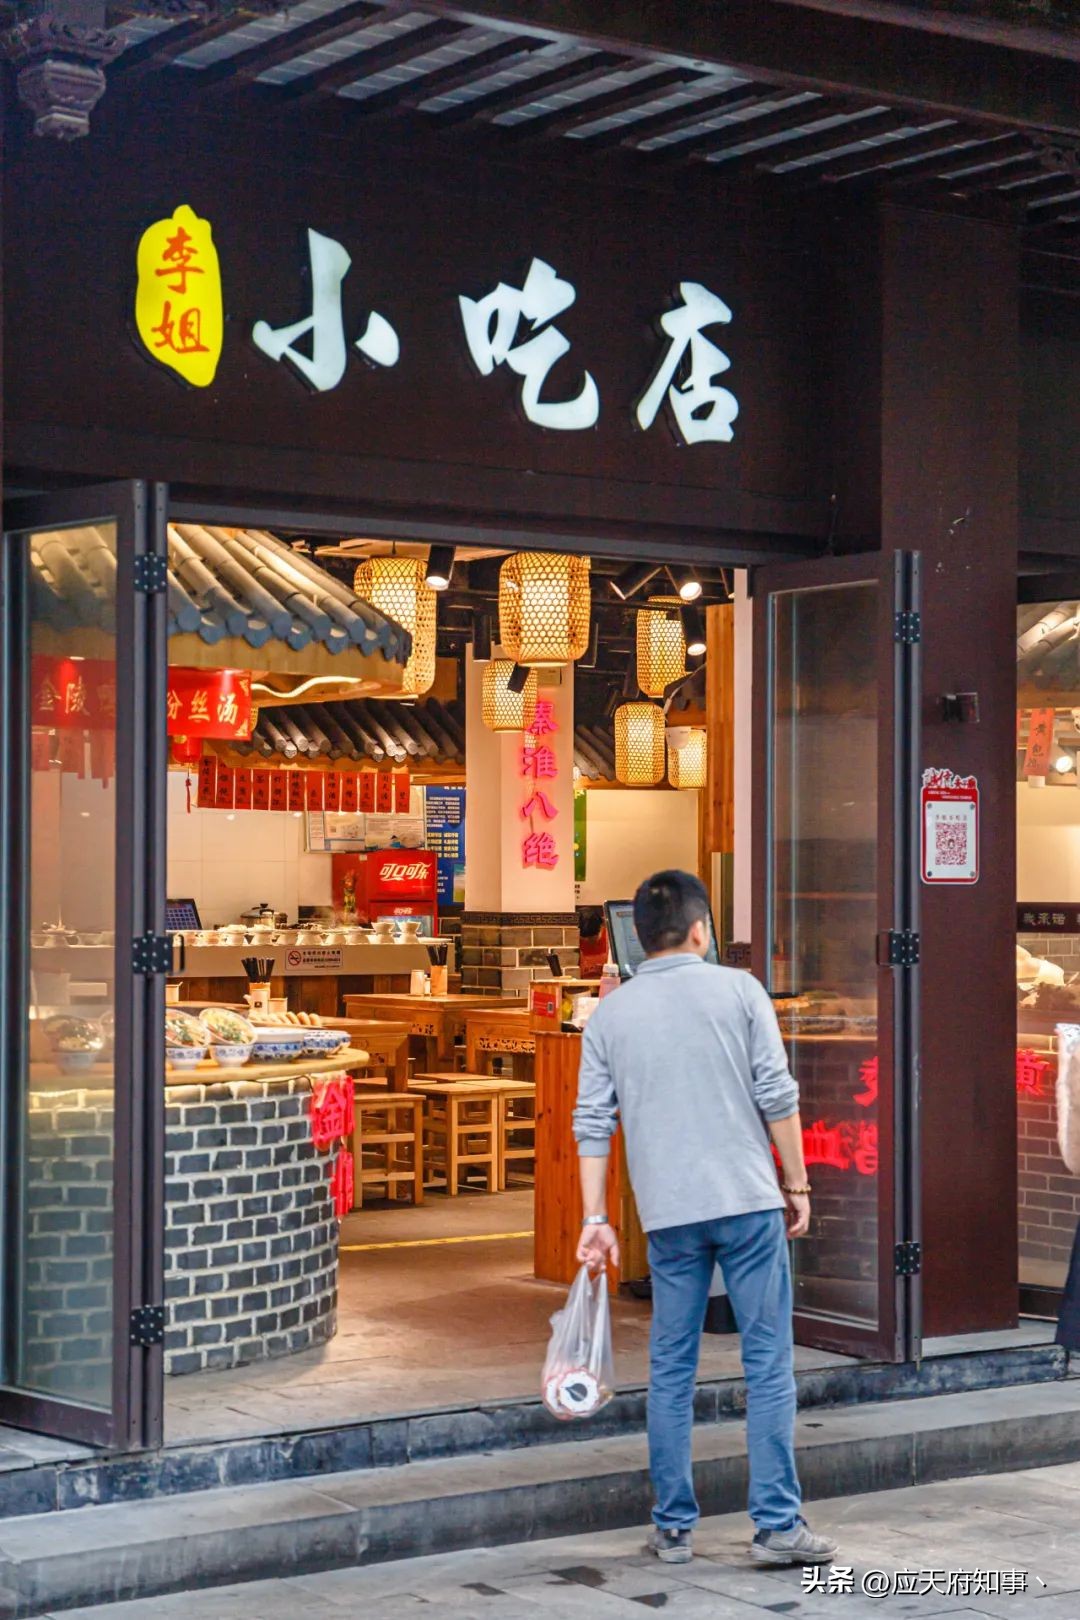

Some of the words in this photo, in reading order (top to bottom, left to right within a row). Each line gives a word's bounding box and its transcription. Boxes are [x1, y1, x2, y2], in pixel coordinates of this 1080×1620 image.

[151, 226, 211, 355] 李姐
[252, 227, 740, 445] 小吃店
[522, 699, 559, 868] 秦淮八绝
[378, 861, 433, 882] 可口可乐
